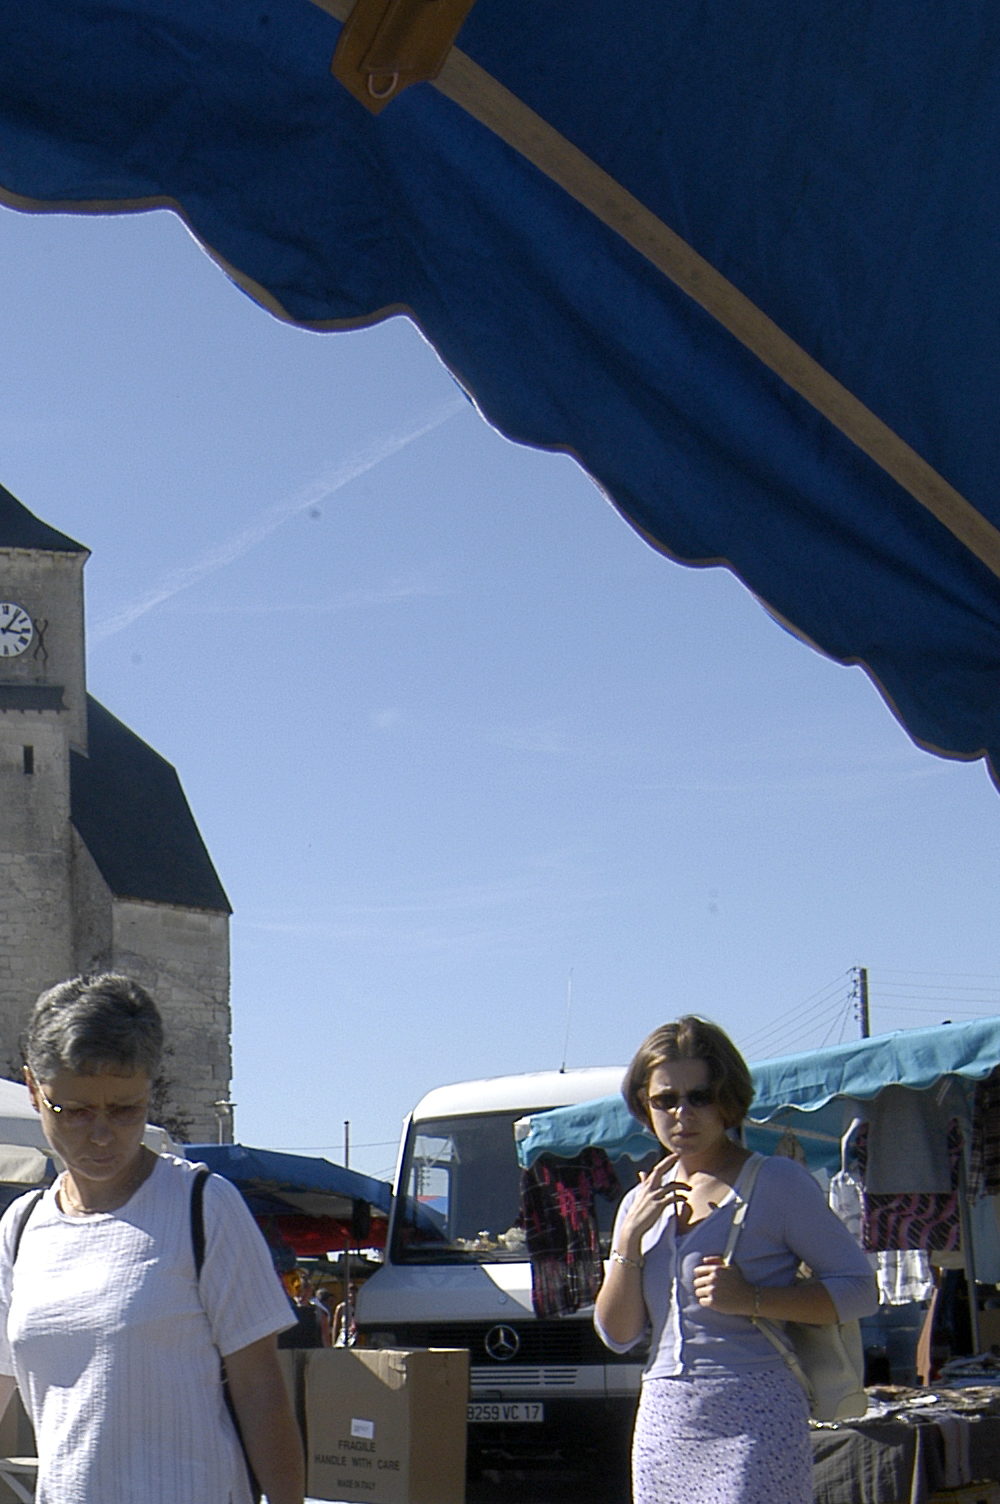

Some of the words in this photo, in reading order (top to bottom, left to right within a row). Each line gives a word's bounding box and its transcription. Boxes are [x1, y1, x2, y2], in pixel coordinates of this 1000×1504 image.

[466, 1406, 499, 1420] 8259
[502, 1406, 519, 1420] VC
[524, 1405, 539, 1420] 17
[338, 1440, 376, 1452] FRAGILE
[314, 1454, 347, 1466] HANDLE
[352, 1457, 372, 1469] WITH
[377, 1459, 400, 1471] CARE
